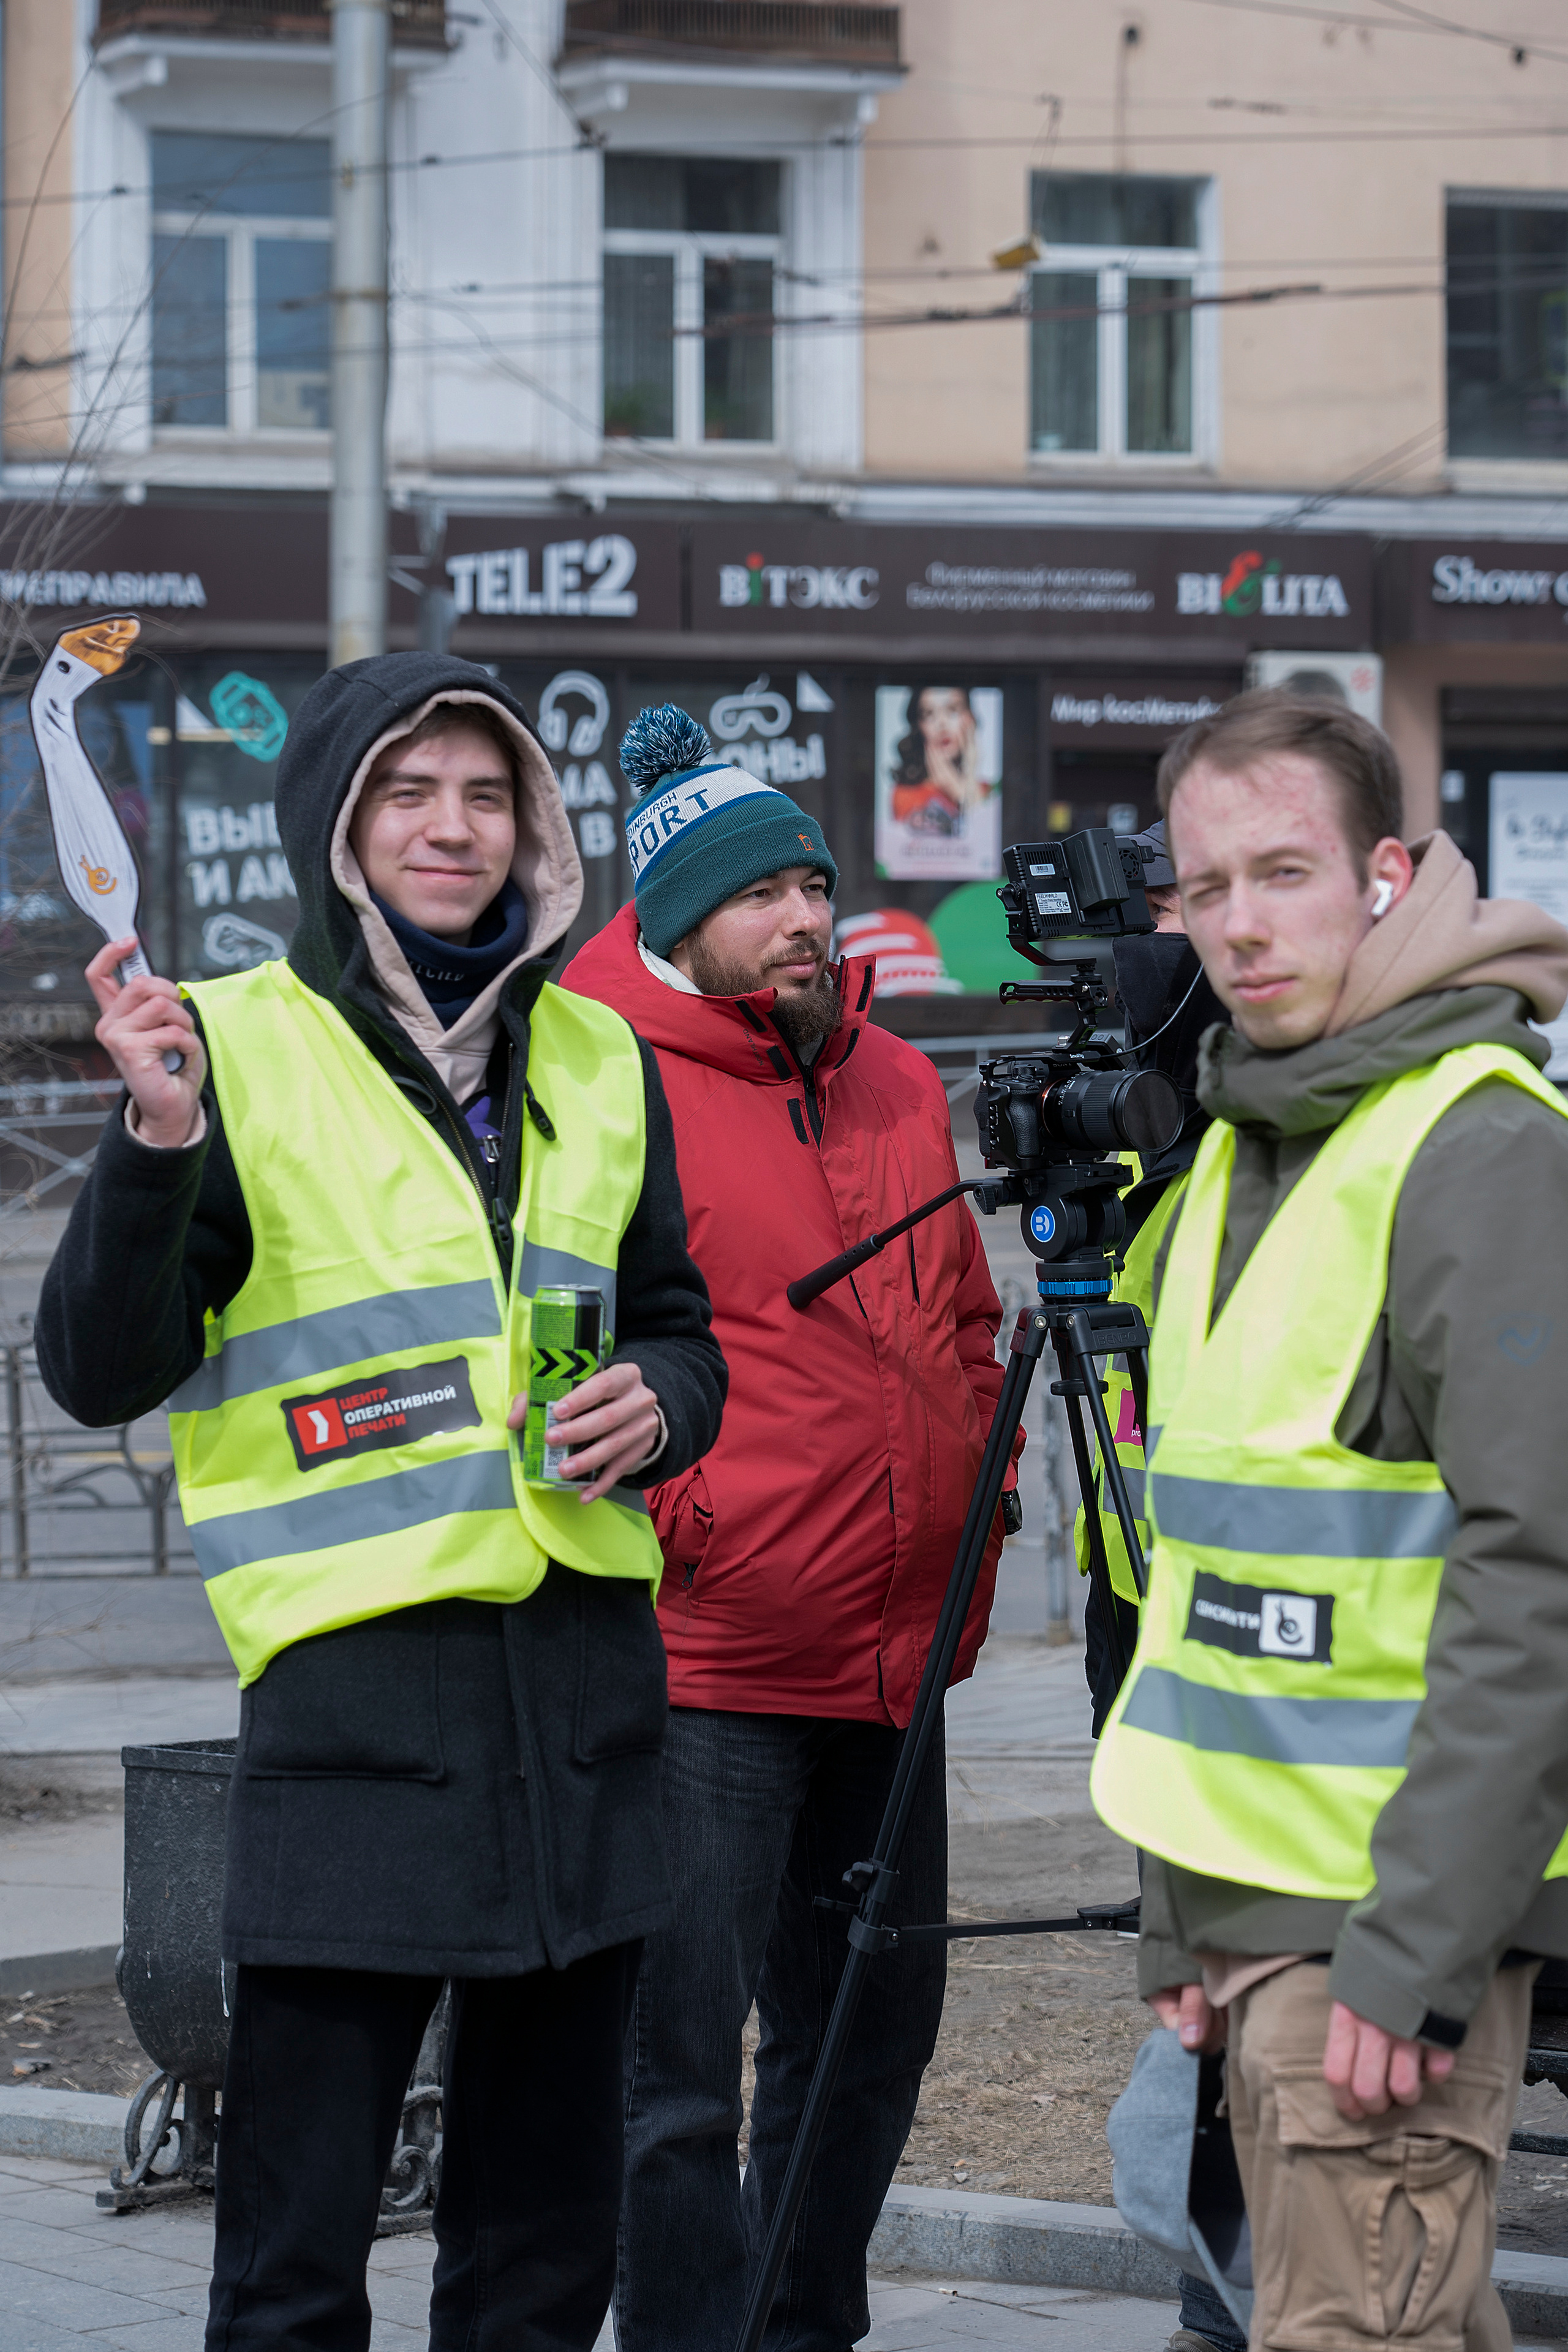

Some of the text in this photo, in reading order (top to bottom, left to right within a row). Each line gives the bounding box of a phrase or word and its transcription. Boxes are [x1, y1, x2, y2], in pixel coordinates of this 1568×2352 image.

[446, 533, 638, 617] TELE2
[625, 792, 677, 840] DINBURGH
[743, 1029, 764, 1066] NORTHLAND
[1097, 1332, 1136, 1346] BENRO
[339, 1387, 388, 1411] ЦЕНТР
[344, 1385, 457, 1425] ОПЕРАТИВНОЙ
[347, 1413, 407, 1439] ПЕЧАТИ
